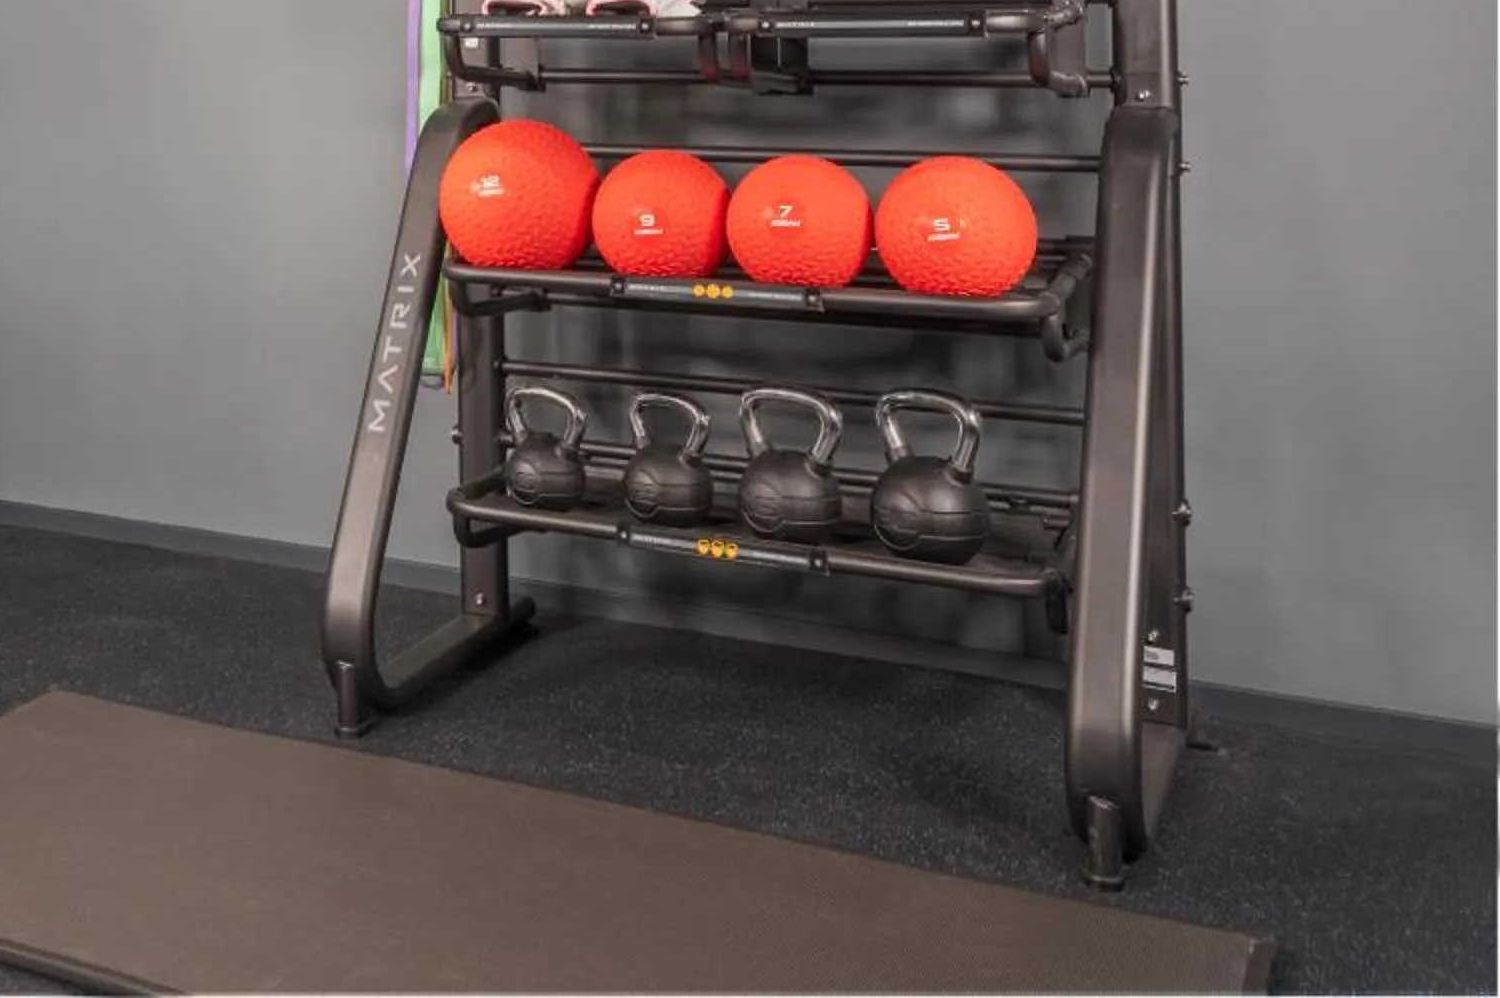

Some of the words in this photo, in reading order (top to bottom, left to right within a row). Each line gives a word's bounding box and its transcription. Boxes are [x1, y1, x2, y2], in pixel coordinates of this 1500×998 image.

[778, 205, 793, 218] 7
[639, 213, 655, 227] 9
[932, 217, 951, 231] 5
[368, 254, 421, 432] MATRIX
